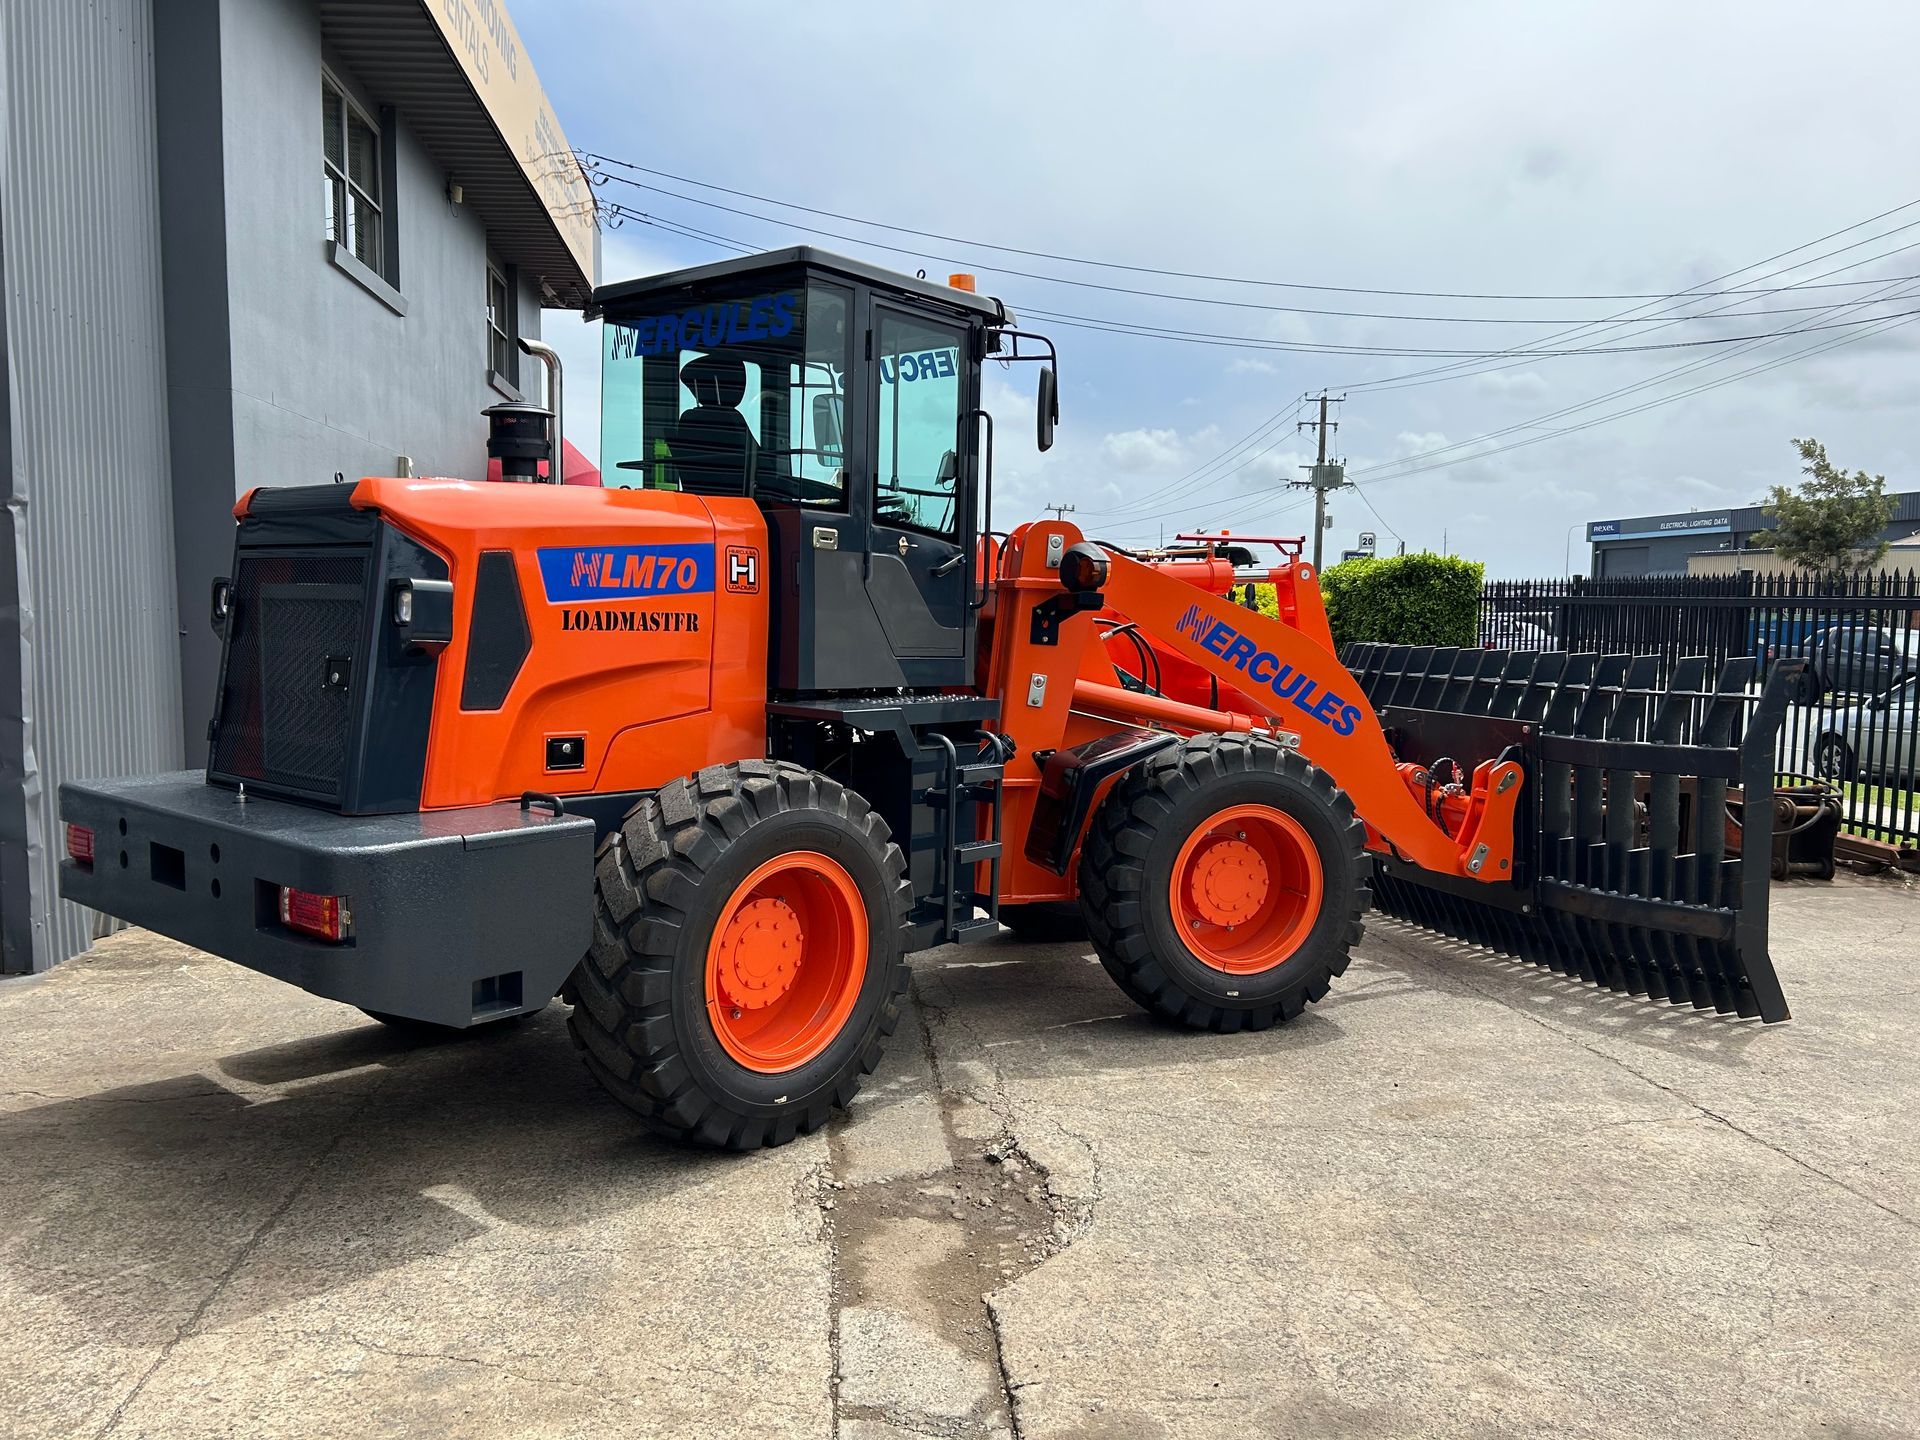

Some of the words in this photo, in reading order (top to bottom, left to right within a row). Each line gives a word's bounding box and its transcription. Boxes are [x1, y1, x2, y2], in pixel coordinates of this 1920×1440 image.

[443, 0, 489, 86] ENTALS
[610, 293, 797, 361] HERCULES
[1362, 537, 1373, 546] 20
[1660, 521, 1688, 529] ELECTRICAL
[1689, 519, 1712, 527] LIGHTING
[1175, 603, 1362, 737] HERCULES
